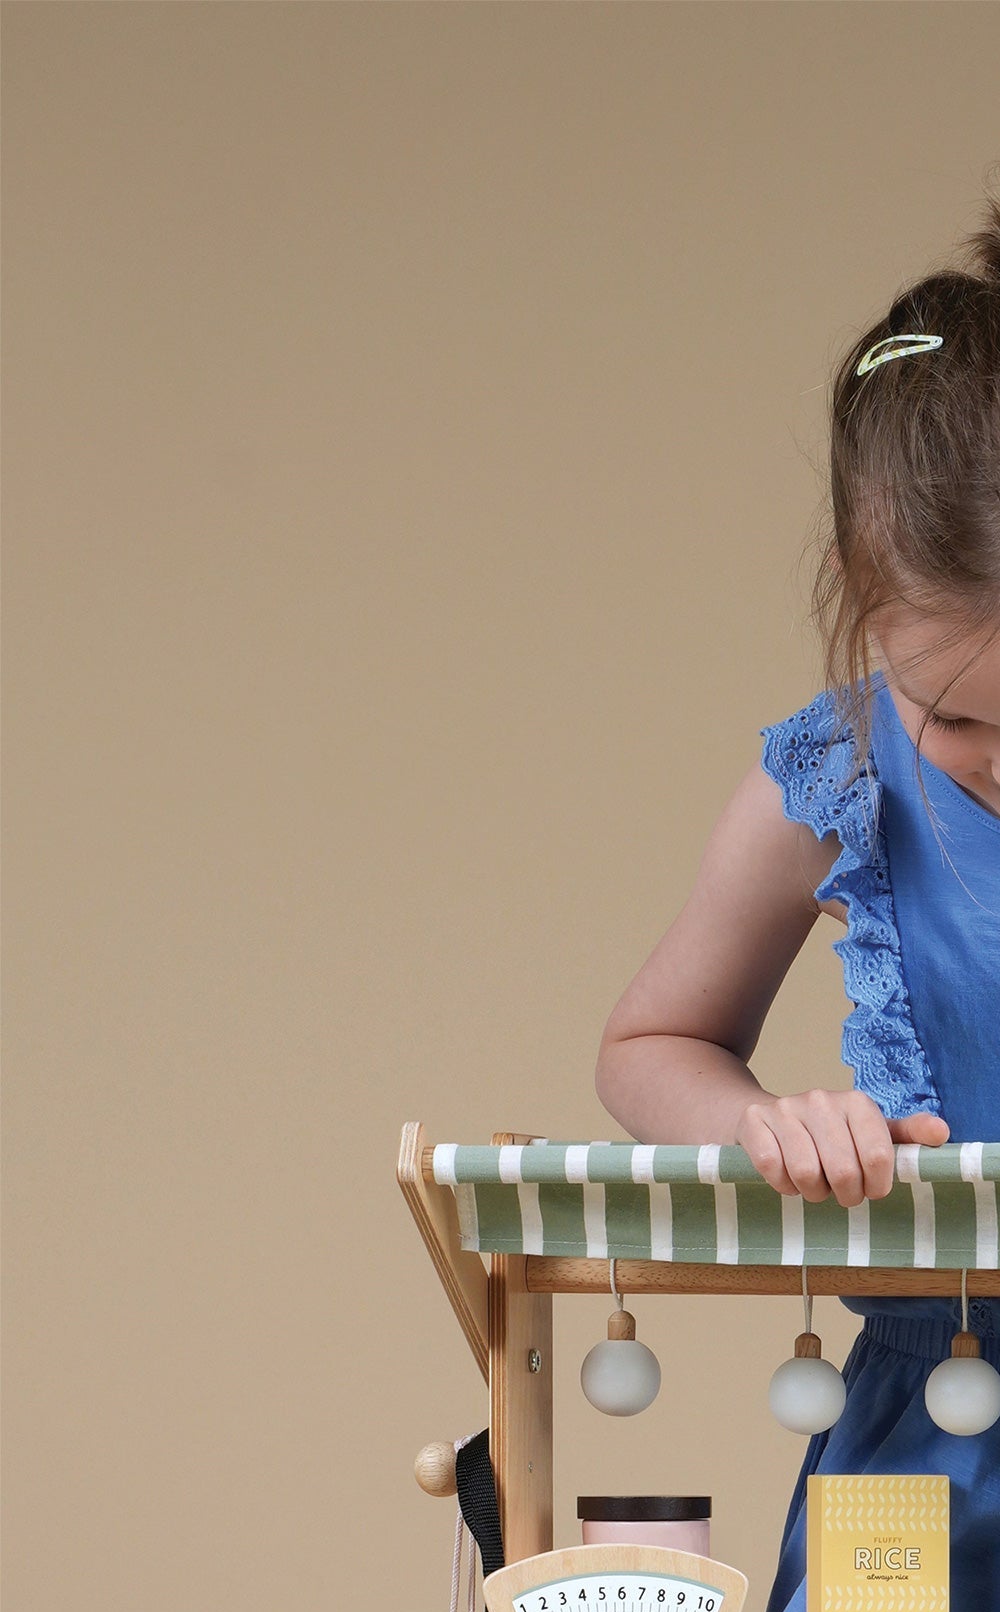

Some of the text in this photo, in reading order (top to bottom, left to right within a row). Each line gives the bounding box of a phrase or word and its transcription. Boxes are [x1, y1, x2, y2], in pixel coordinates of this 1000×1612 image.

[855, 1547, 921, 1570] RICE
[867, 1574, 893, 1582] always
[538, 1596, 548, 1610] 2
[558, 1592, 567, 1605] 3
[578, 1588, 587, 1601] 4
[598, 1587, 606, 1600] 5
[617, 1587, 626, 1600] 6
[638, 1587, 646, 1600] 7
[657, 1589, 666, 1602] 8
[677, 1592, 686, 1605] 9
[698, 1596, 715, 1612] 10
